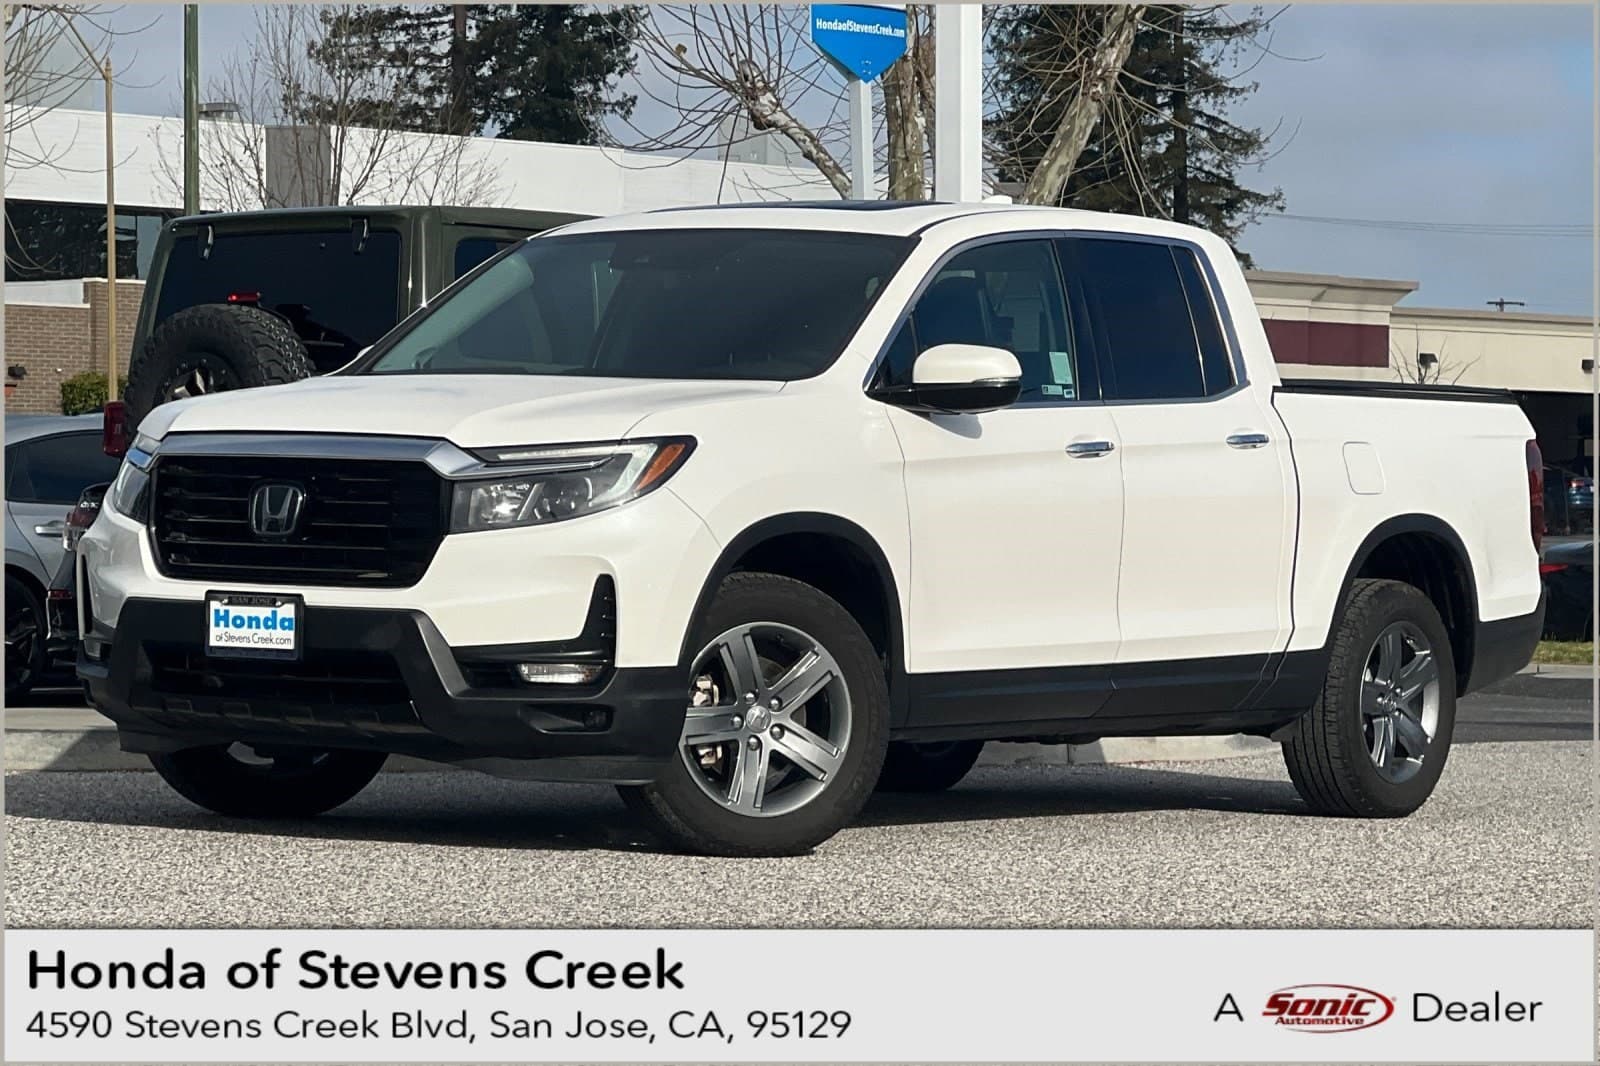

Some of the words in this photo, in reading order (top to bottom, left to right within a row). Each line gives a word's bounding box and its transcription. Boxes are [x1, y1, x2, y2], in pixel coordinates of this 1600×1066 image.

[816, 18, 905, 38] HondaofStevensCreek.com
[214, 608, 294, 631] Honda
[215, 633, 223, 642] of
[224, 632, 250, 644] Stevens
[252, 632, 292, 646] Creek.com
